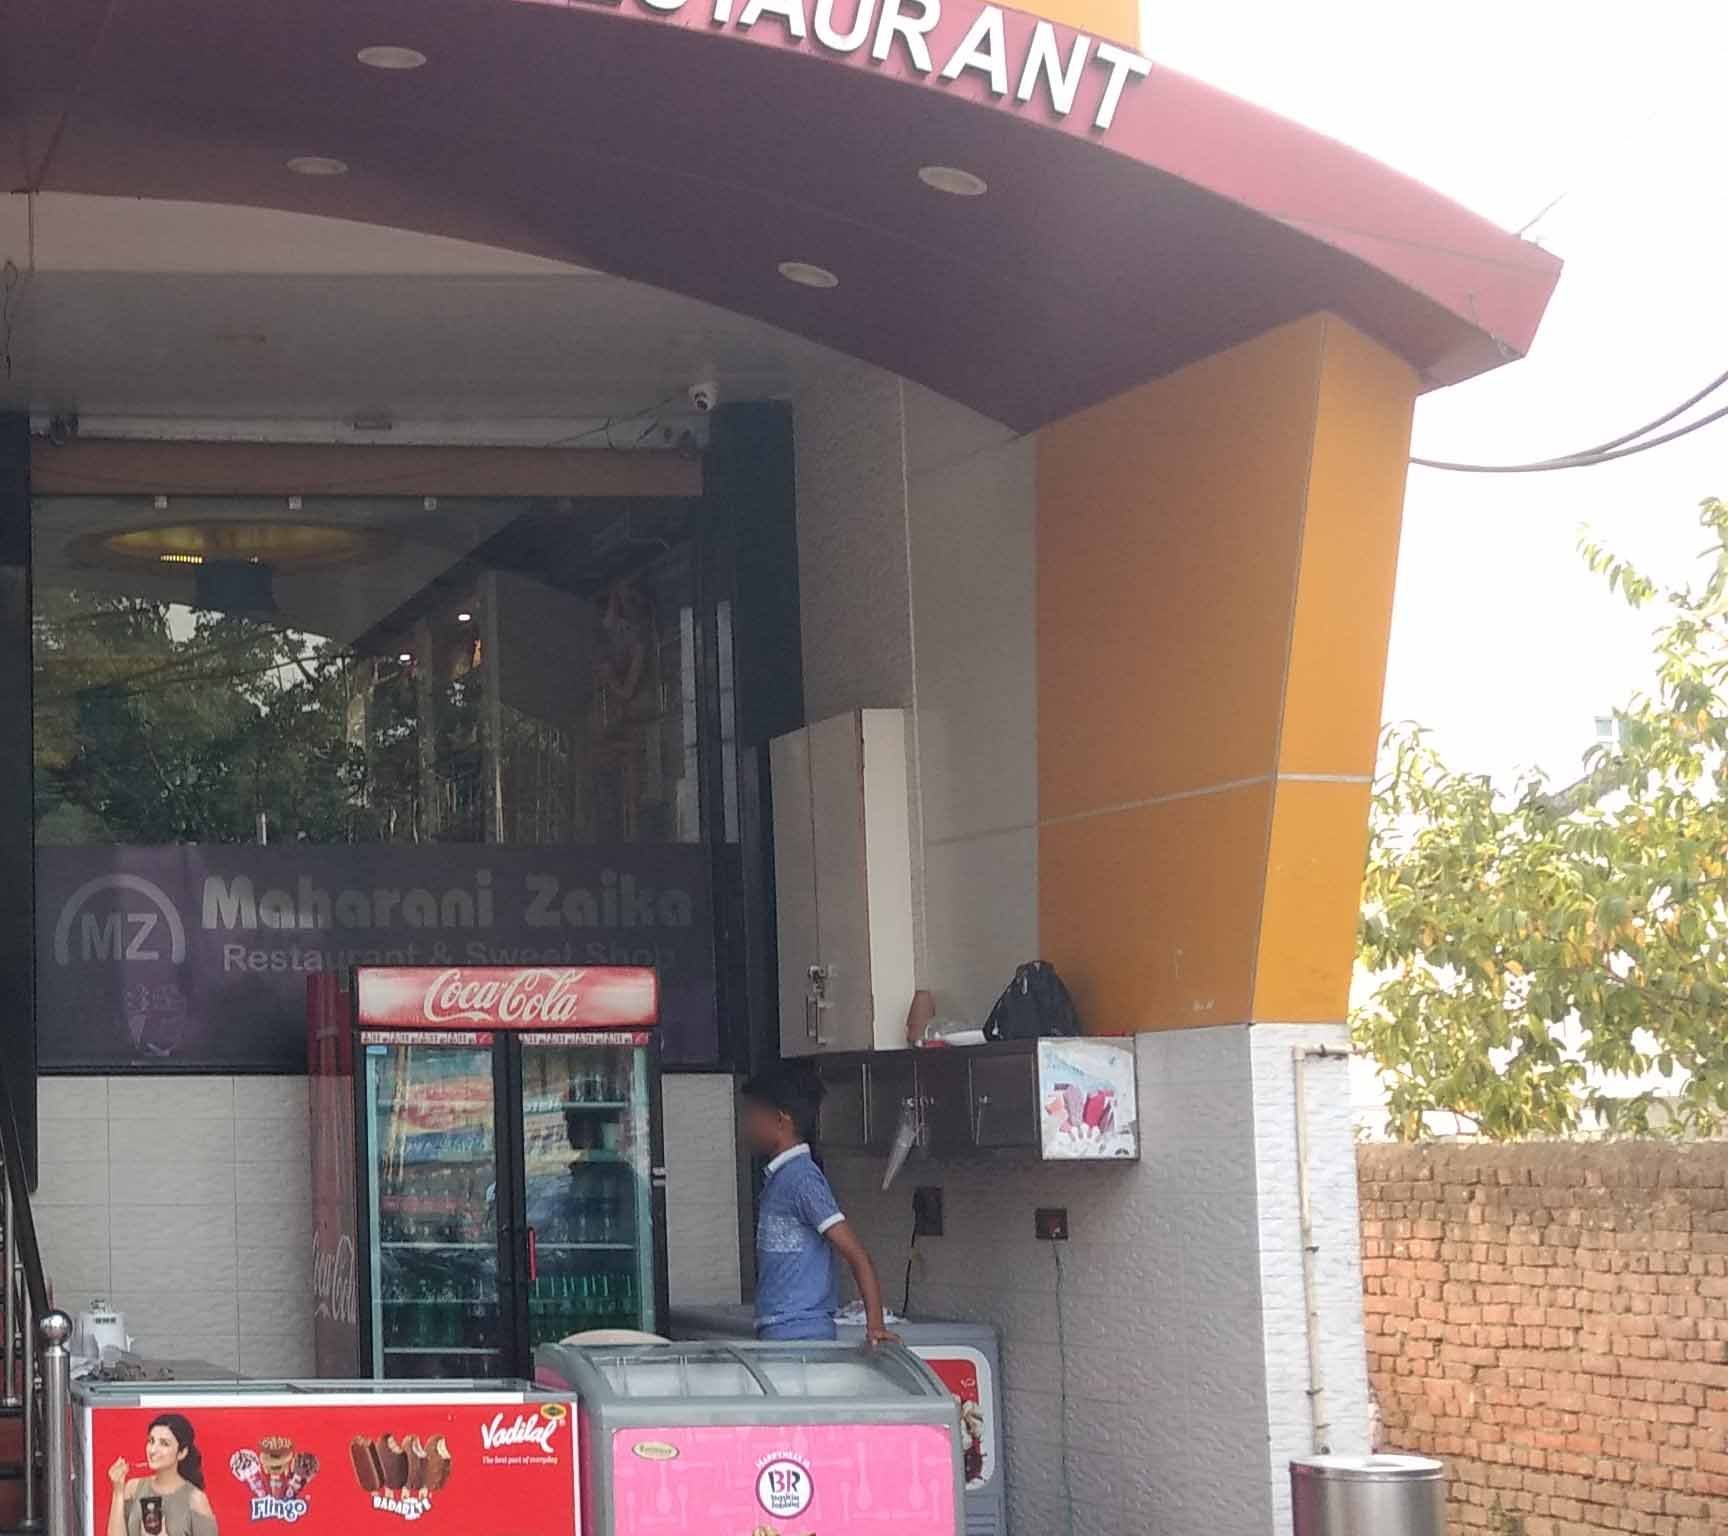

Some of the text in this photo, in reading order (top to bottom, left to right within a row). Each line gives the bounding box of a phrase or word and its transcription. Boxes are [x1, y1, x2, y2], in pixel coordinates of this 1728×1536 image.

[201, 869, 693, 930] Maharani Zaika
[80, 911, 158, 962] MZ
[223, 942, 420, 972] Restaurant
[480, 1412, 557, 1454] Vadilal
[768, 1469, 801, 1493] BR
[251, 1495, 307, 1522] Flingo
